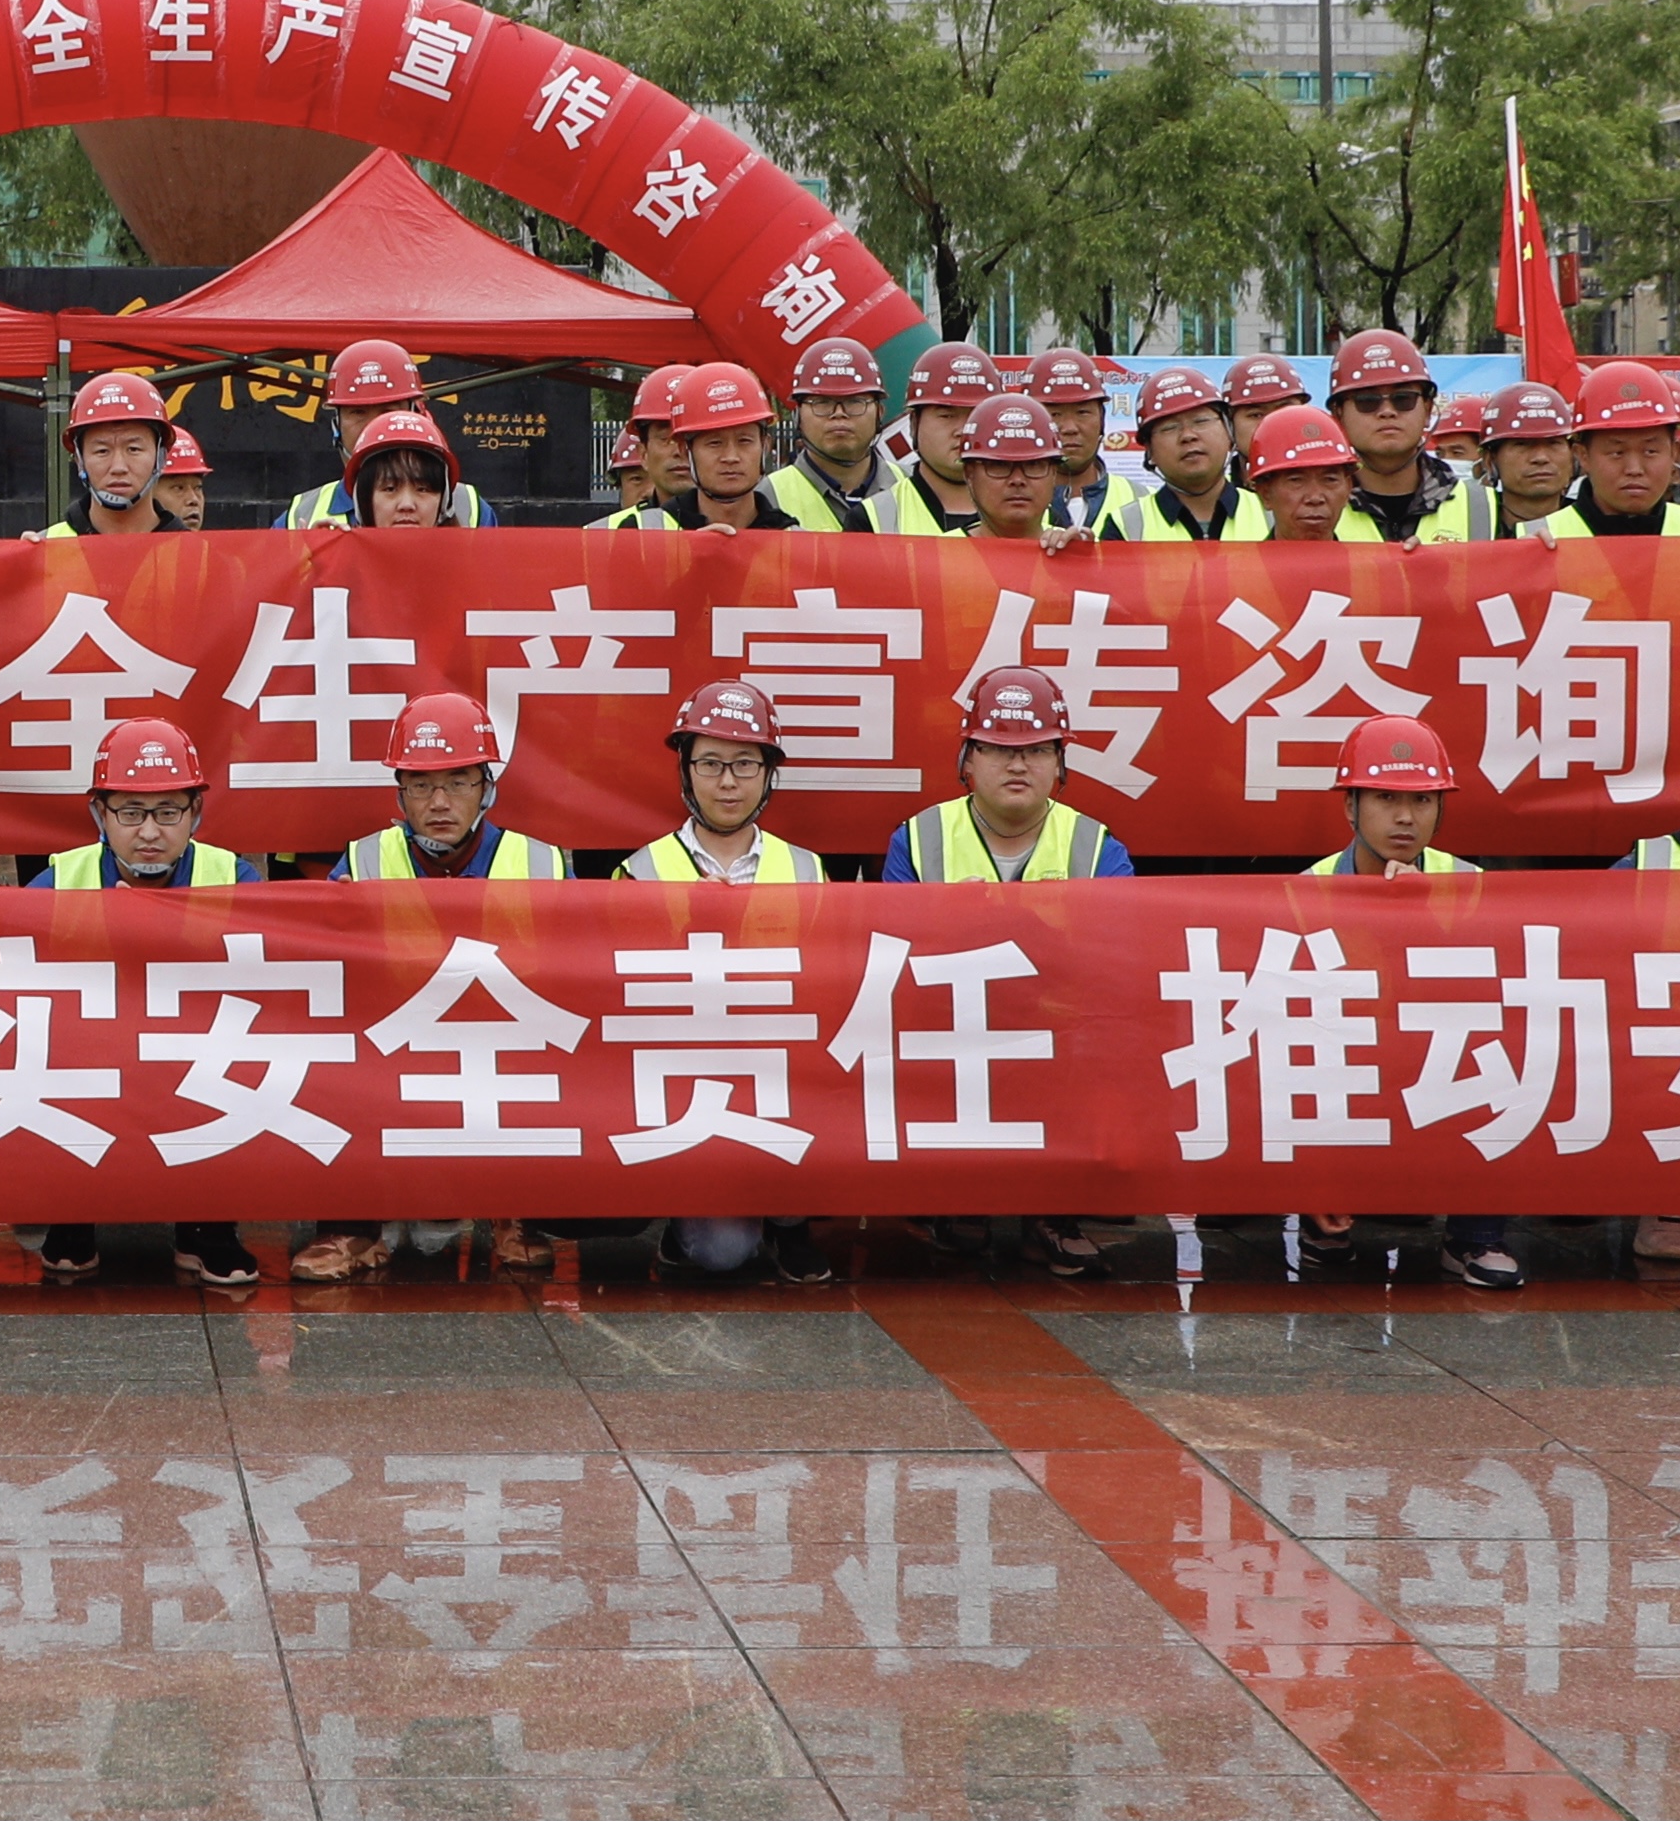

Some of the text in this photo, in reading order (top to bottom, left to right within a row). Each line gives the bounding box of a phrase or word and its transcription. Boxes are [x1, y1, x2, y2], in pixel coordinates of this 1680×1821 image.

[818, 366, 856, 377] 中国铁建
[946, 374, 986, 386] 中国铁建
[708, 399, 744, 414] 中国铁建
[1516, 409, 1558, 420] 中国铁建
[462, 424, 546, 438] 积石山县人民政府
[994, 428, 1036, 440] 中国铁建
[710, 706, 756, 724] 中国铁建
[989, 708, 1035, 722] 中国铁建
[408, 738, 446, 749] 中国铁建
[134, 756, 176, 768] 中国铁建
